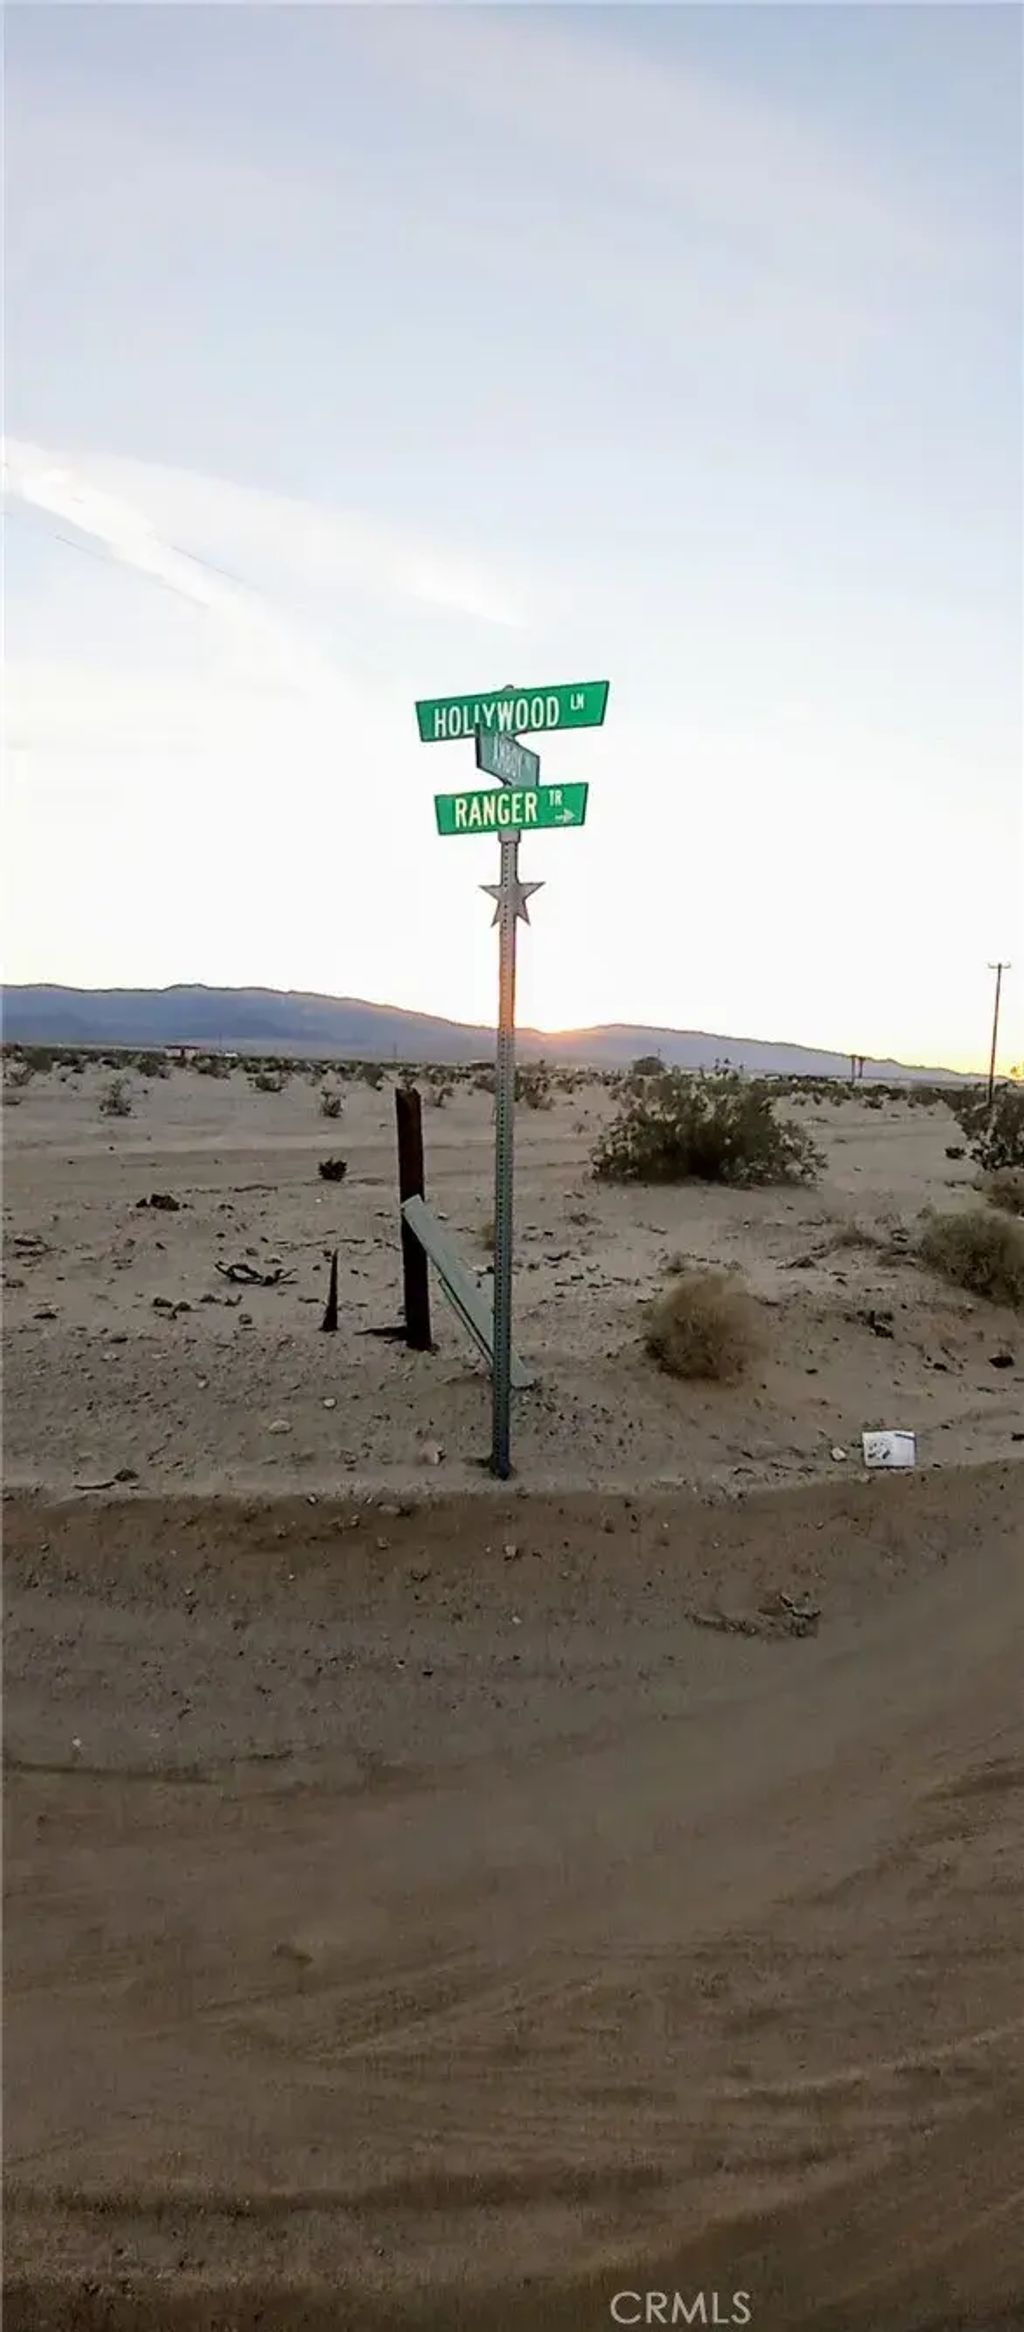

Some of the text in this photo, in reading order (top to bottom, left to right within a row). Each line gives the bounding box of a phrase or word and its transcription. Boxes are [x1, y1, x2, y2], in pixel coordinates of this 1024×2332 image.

[434, 693, 584, 738] HOLLYWOOD LN
[455, 789, 563, 828] RANGER TR
